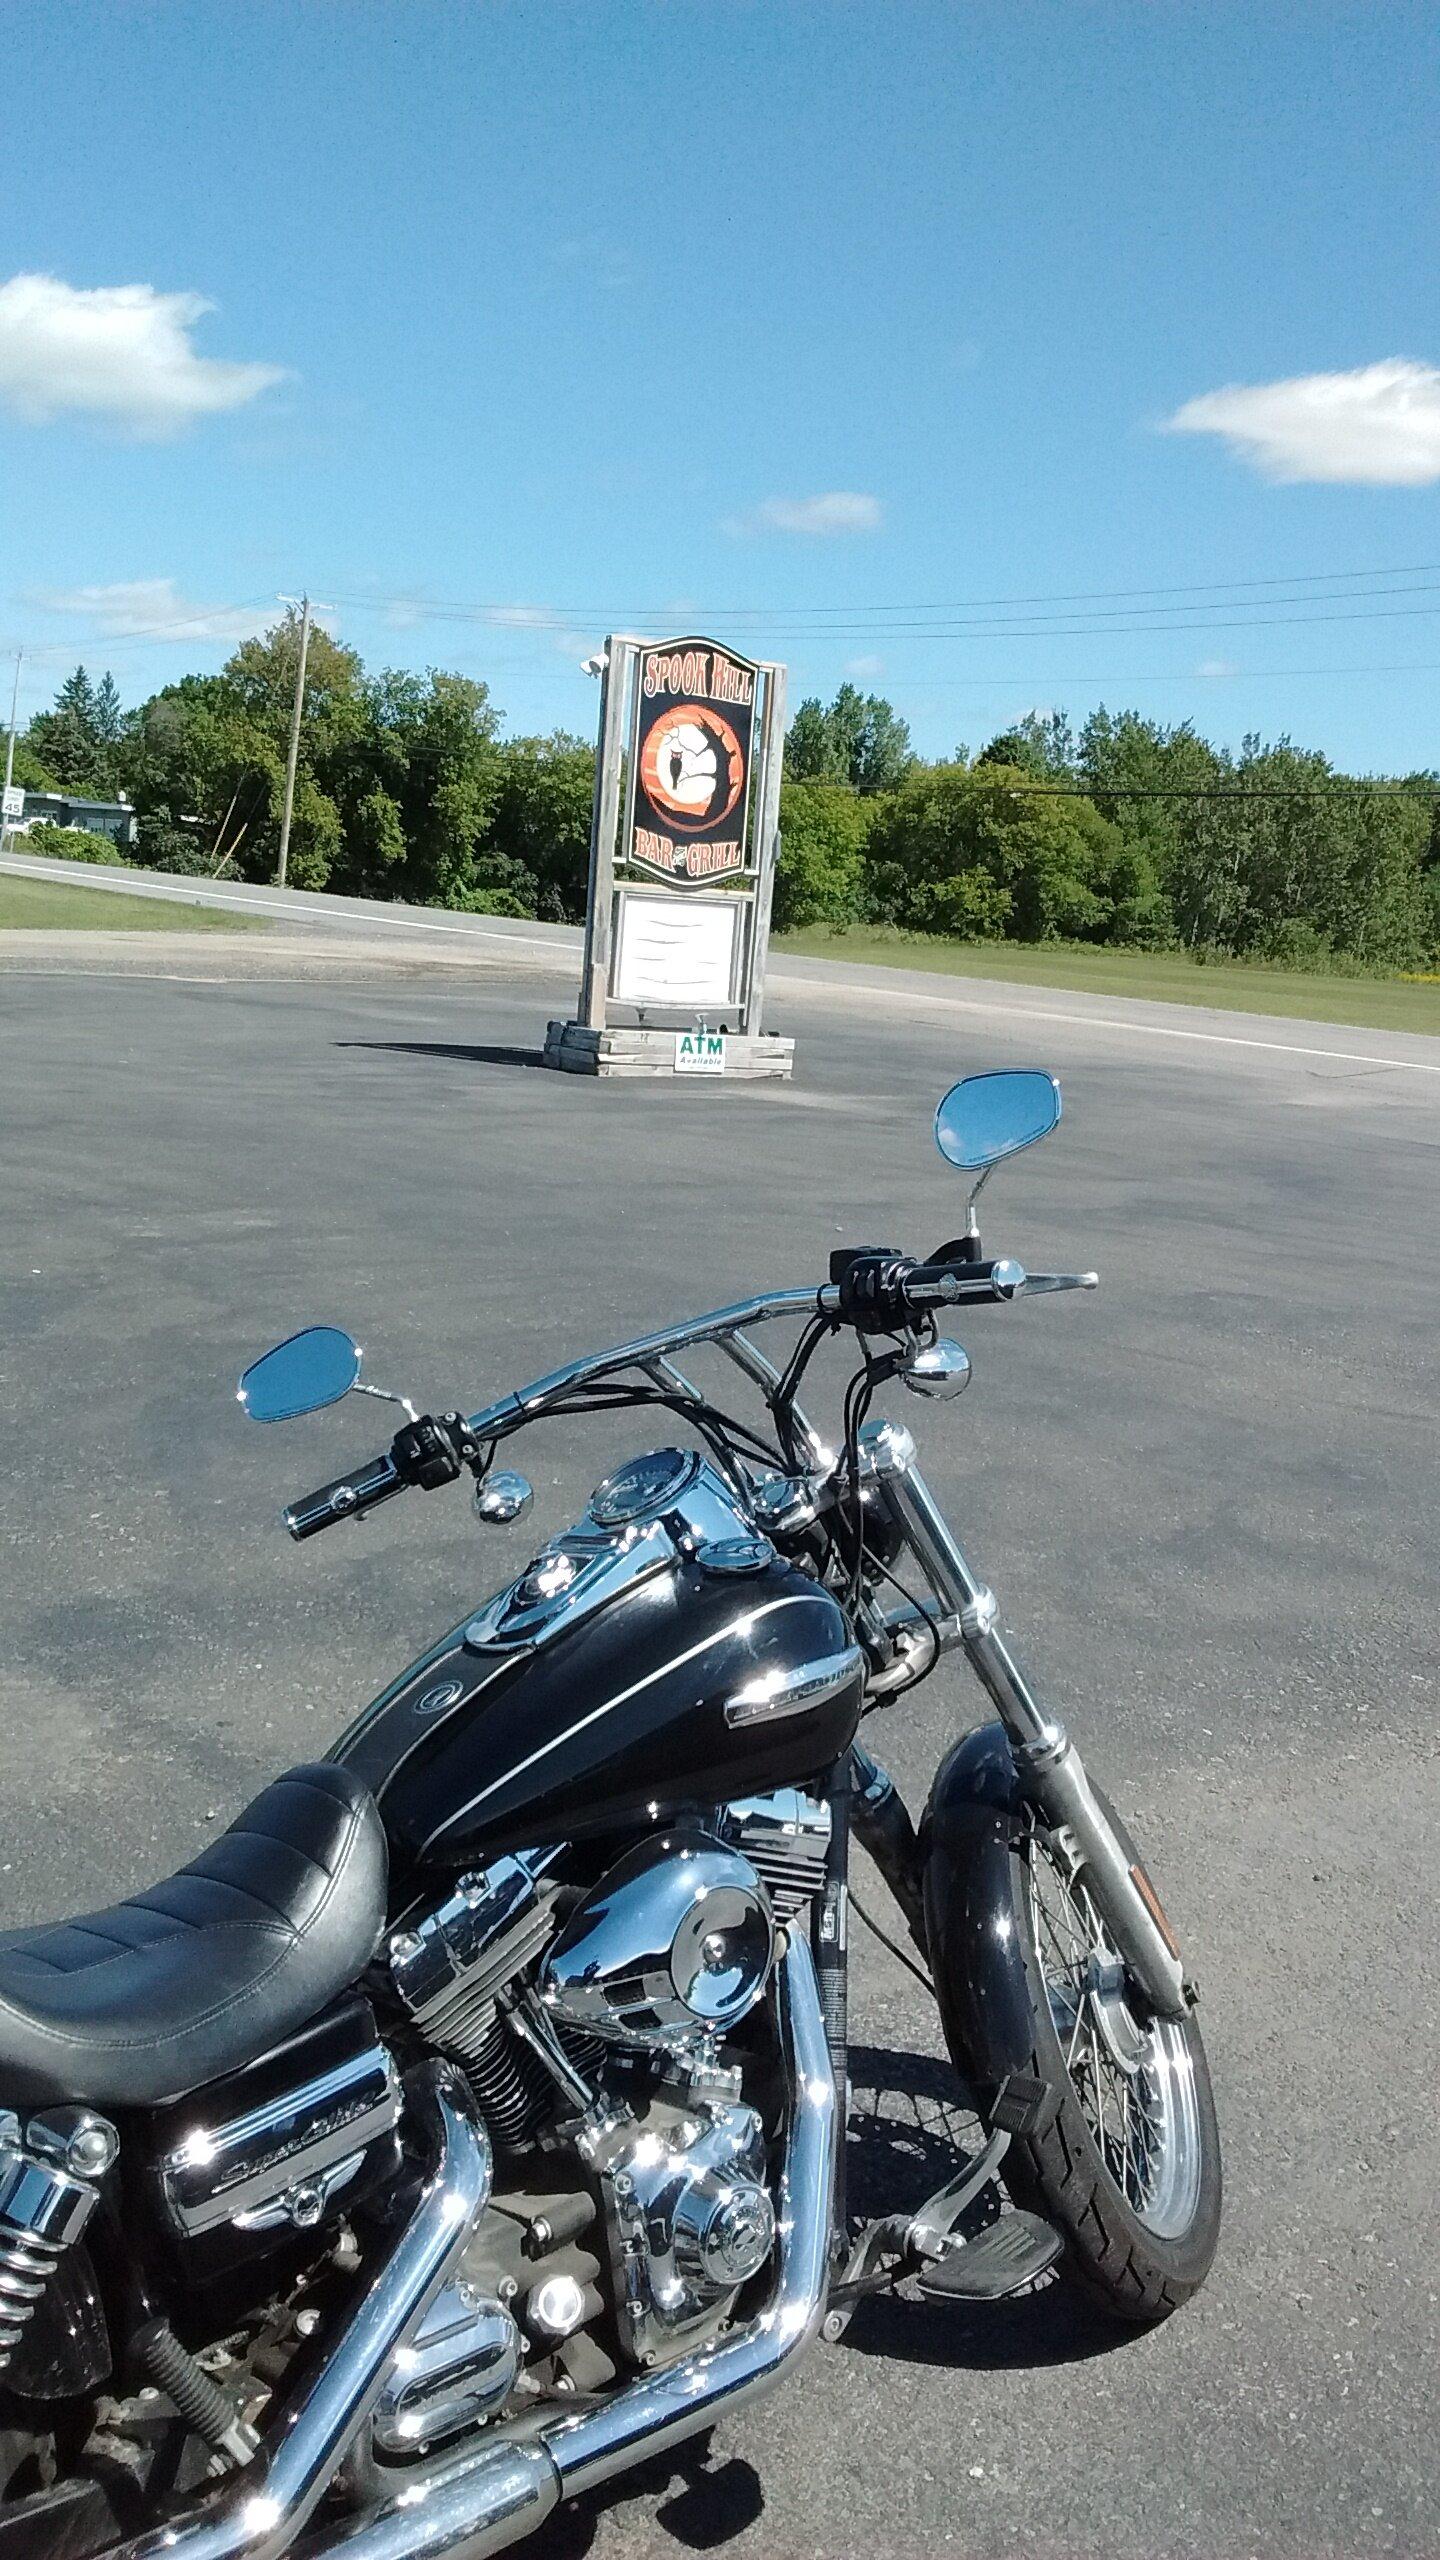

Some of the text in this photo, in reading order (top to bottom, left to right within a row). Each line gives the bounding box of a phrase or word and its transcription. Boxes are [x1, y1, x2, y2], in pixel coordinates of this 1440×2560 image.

[644, 651, 752, 706] SPOOK HILL
[5, 803, 20, 813] 45
[634, 826, 677, 874] BAR
[686, 841, 741, 877] GRILL
[680, 1036, 723, 1055] ATM
[680, 1056, 722, 1065] Available
